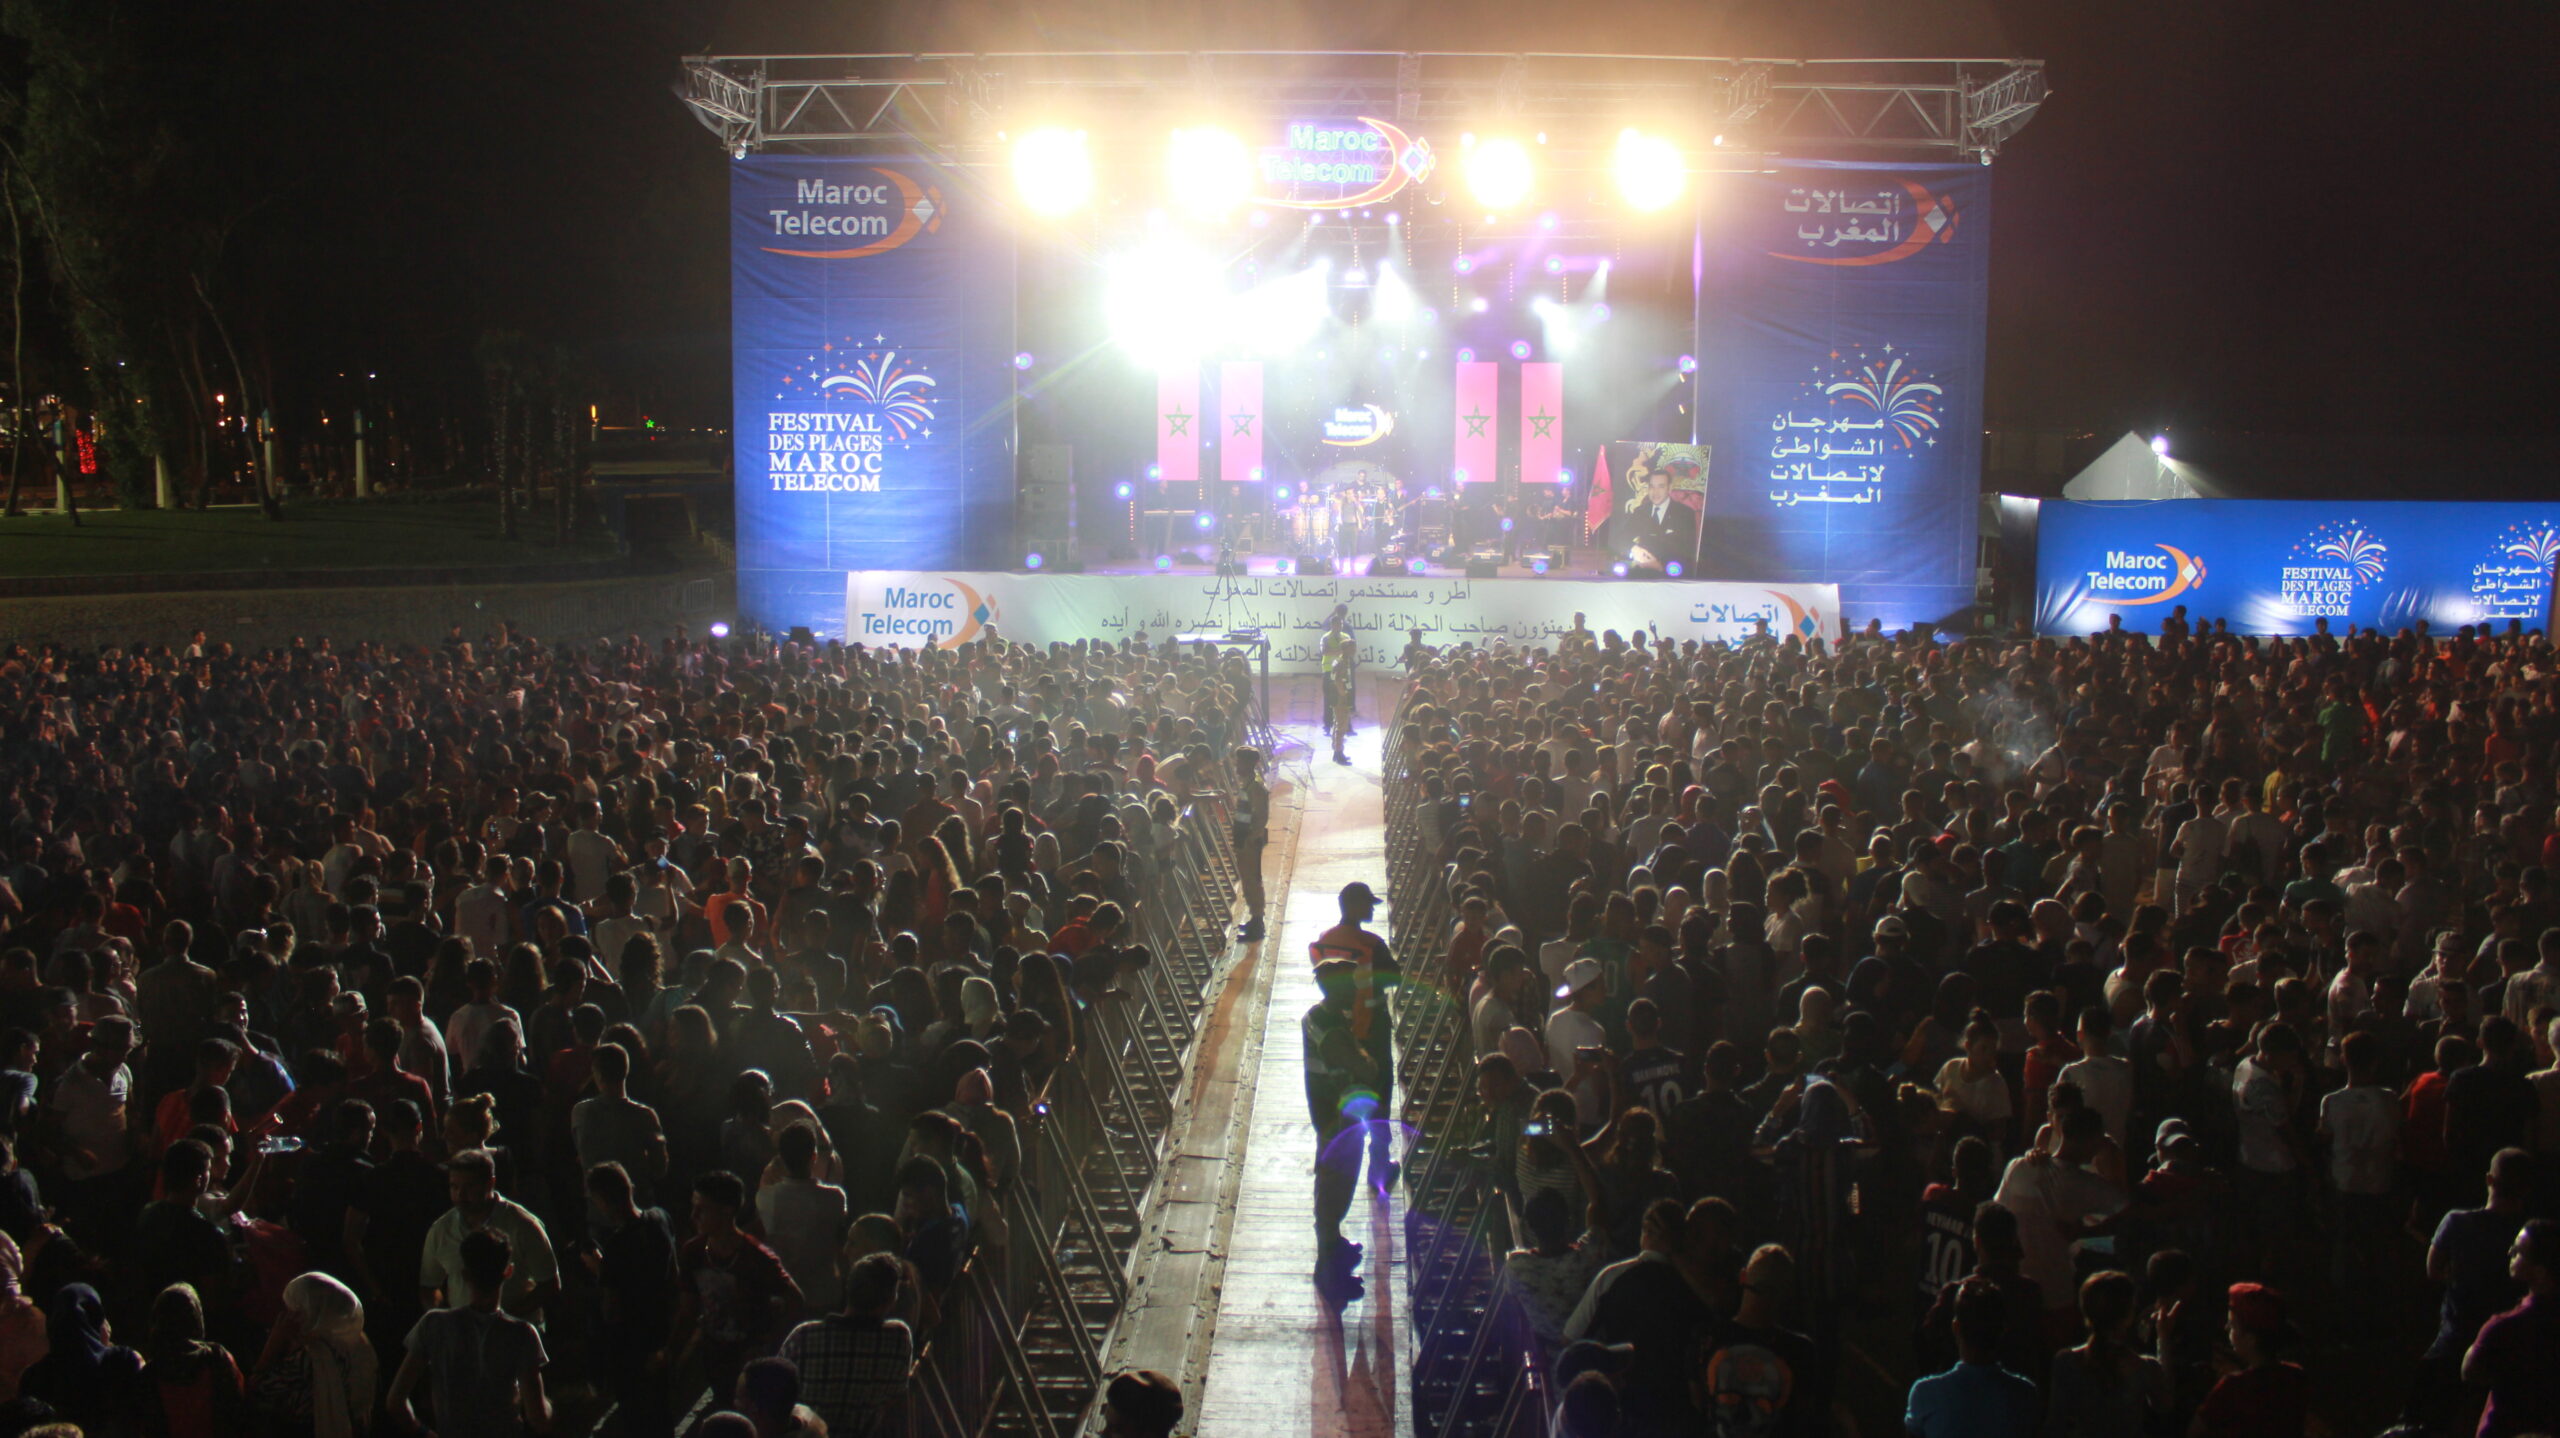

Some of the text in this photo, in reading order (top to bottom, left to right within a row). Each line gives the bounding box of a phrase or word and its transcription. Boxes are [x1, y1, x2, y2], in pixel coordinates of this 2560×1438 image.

[1290, 124, 1378, 151] Maroc
[1260, 154, 1375, 184] Telecom
[797, 178, 887, 204] Maroc
[1784, 187, 1899, 215] اتصالات
[769, 210, 888, 235] Telecom
[1798, 217, 1899, 247] المغرب
[768, 413, 882, 432] FESTIVAL
[1772, 411, 1885, 434] مهرجان
[769, 434, 883, 452] DES PLAGES
[1771, 436, 1884, 460] الشواطئ
[768, 452, 883, 473] MAROC
[1770, 462, 1885, 482] لاتصالات
[769, 473, 881, 492] TELECOM
[1769, 485, 1881, 507] المغرب
[2106, 551, 2167, 569] Maroc
[2472, 563, 2541, 576] مهرجان
[2087, 571, 2166, 590] Telecom
[2282, 567, 2352, 580] FESTIVAL
[1440, 579, 1471, 605] أطر
[2281, 580, 2352, 592] DES PLAGES
[2471, 578, 2540, 592] الشواطئ
[884, 587, 955, 609] Maroc
[1424, 589, 1434, 605] و
[2281, 592, 2352, 604] MAROC
[2470, 594, 2541, 606] لاتصالات
[1150, 609, 1169, 628] الله
[1690, 603, 1779, 623] اتصالات
[2283, 605, 2349, 617] ELECOM
[2471, 607, 2538, 621] المغرب
[862, 613, 953, 636] Telecom
[1293, 617, 1323, 630] حمد
[1449, 616, 1509, 638] صاحب
[1926, 1232, 1963, 1284] 10
